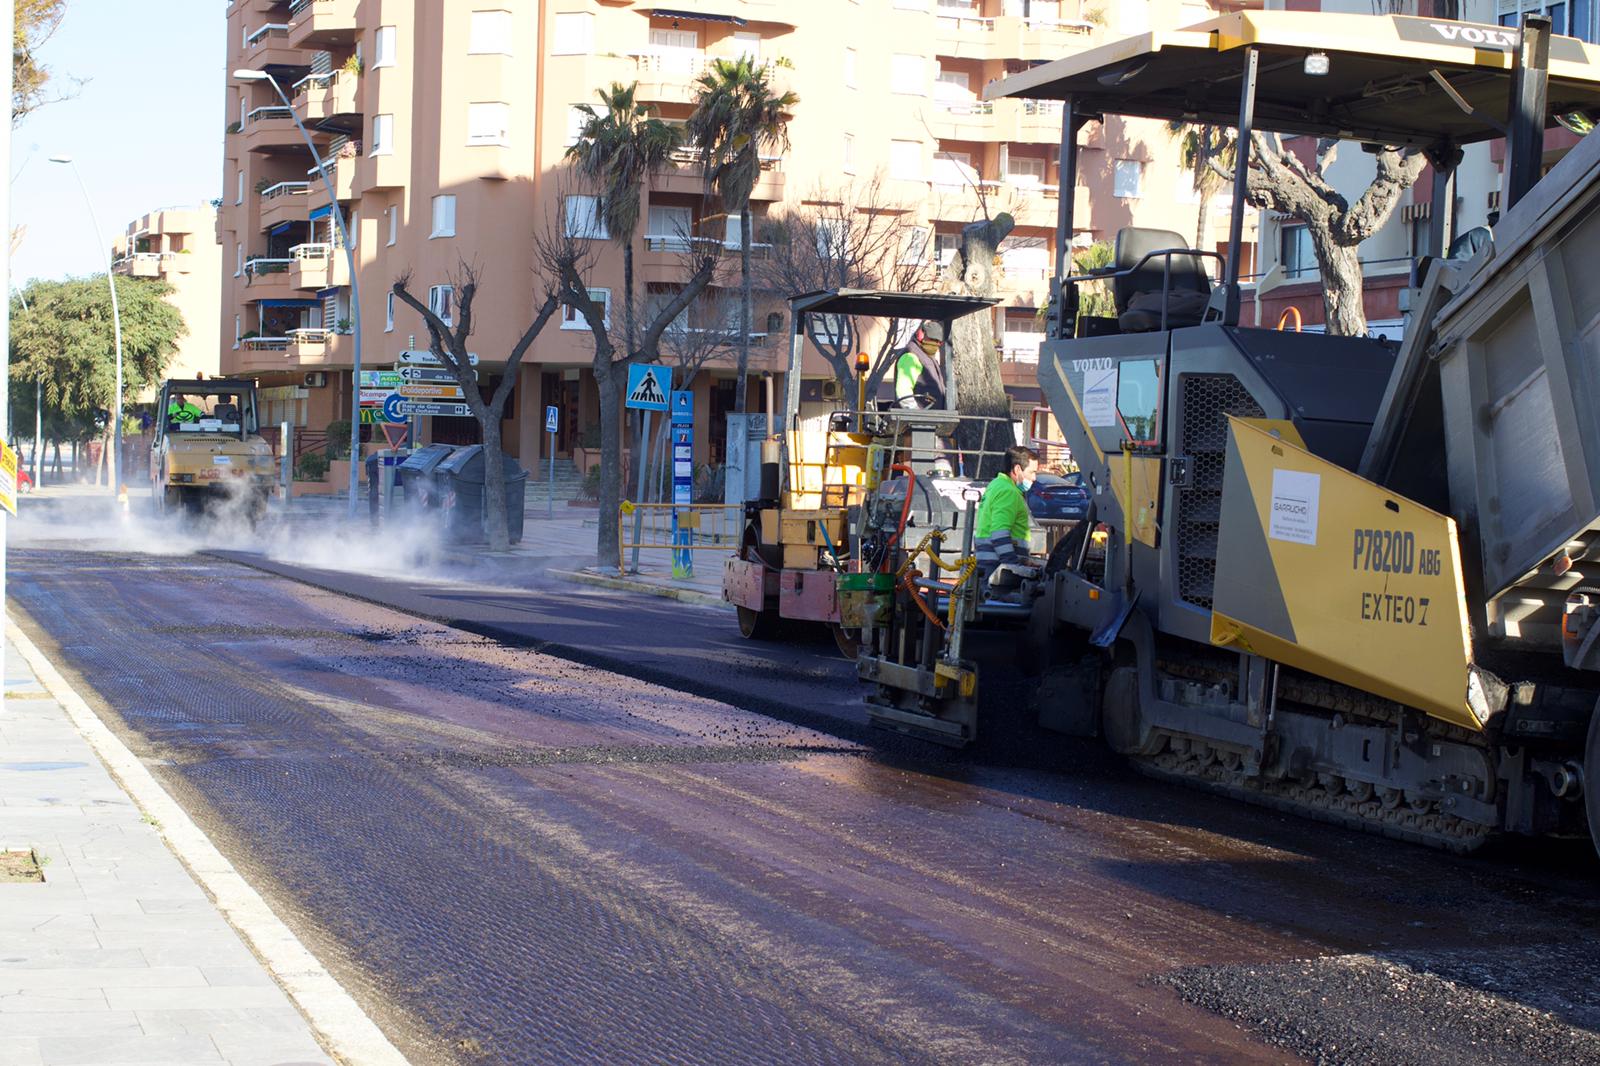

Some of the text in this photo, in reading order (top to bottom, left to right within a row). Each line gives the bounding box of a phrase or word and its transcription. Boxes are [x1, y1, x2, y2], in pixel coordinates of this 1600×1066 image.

[1072, 357, 1112, 372] VOLVO
[1353, 528, 1415, 574] P7820D
[1419, 548, 1441, 576] ABG
